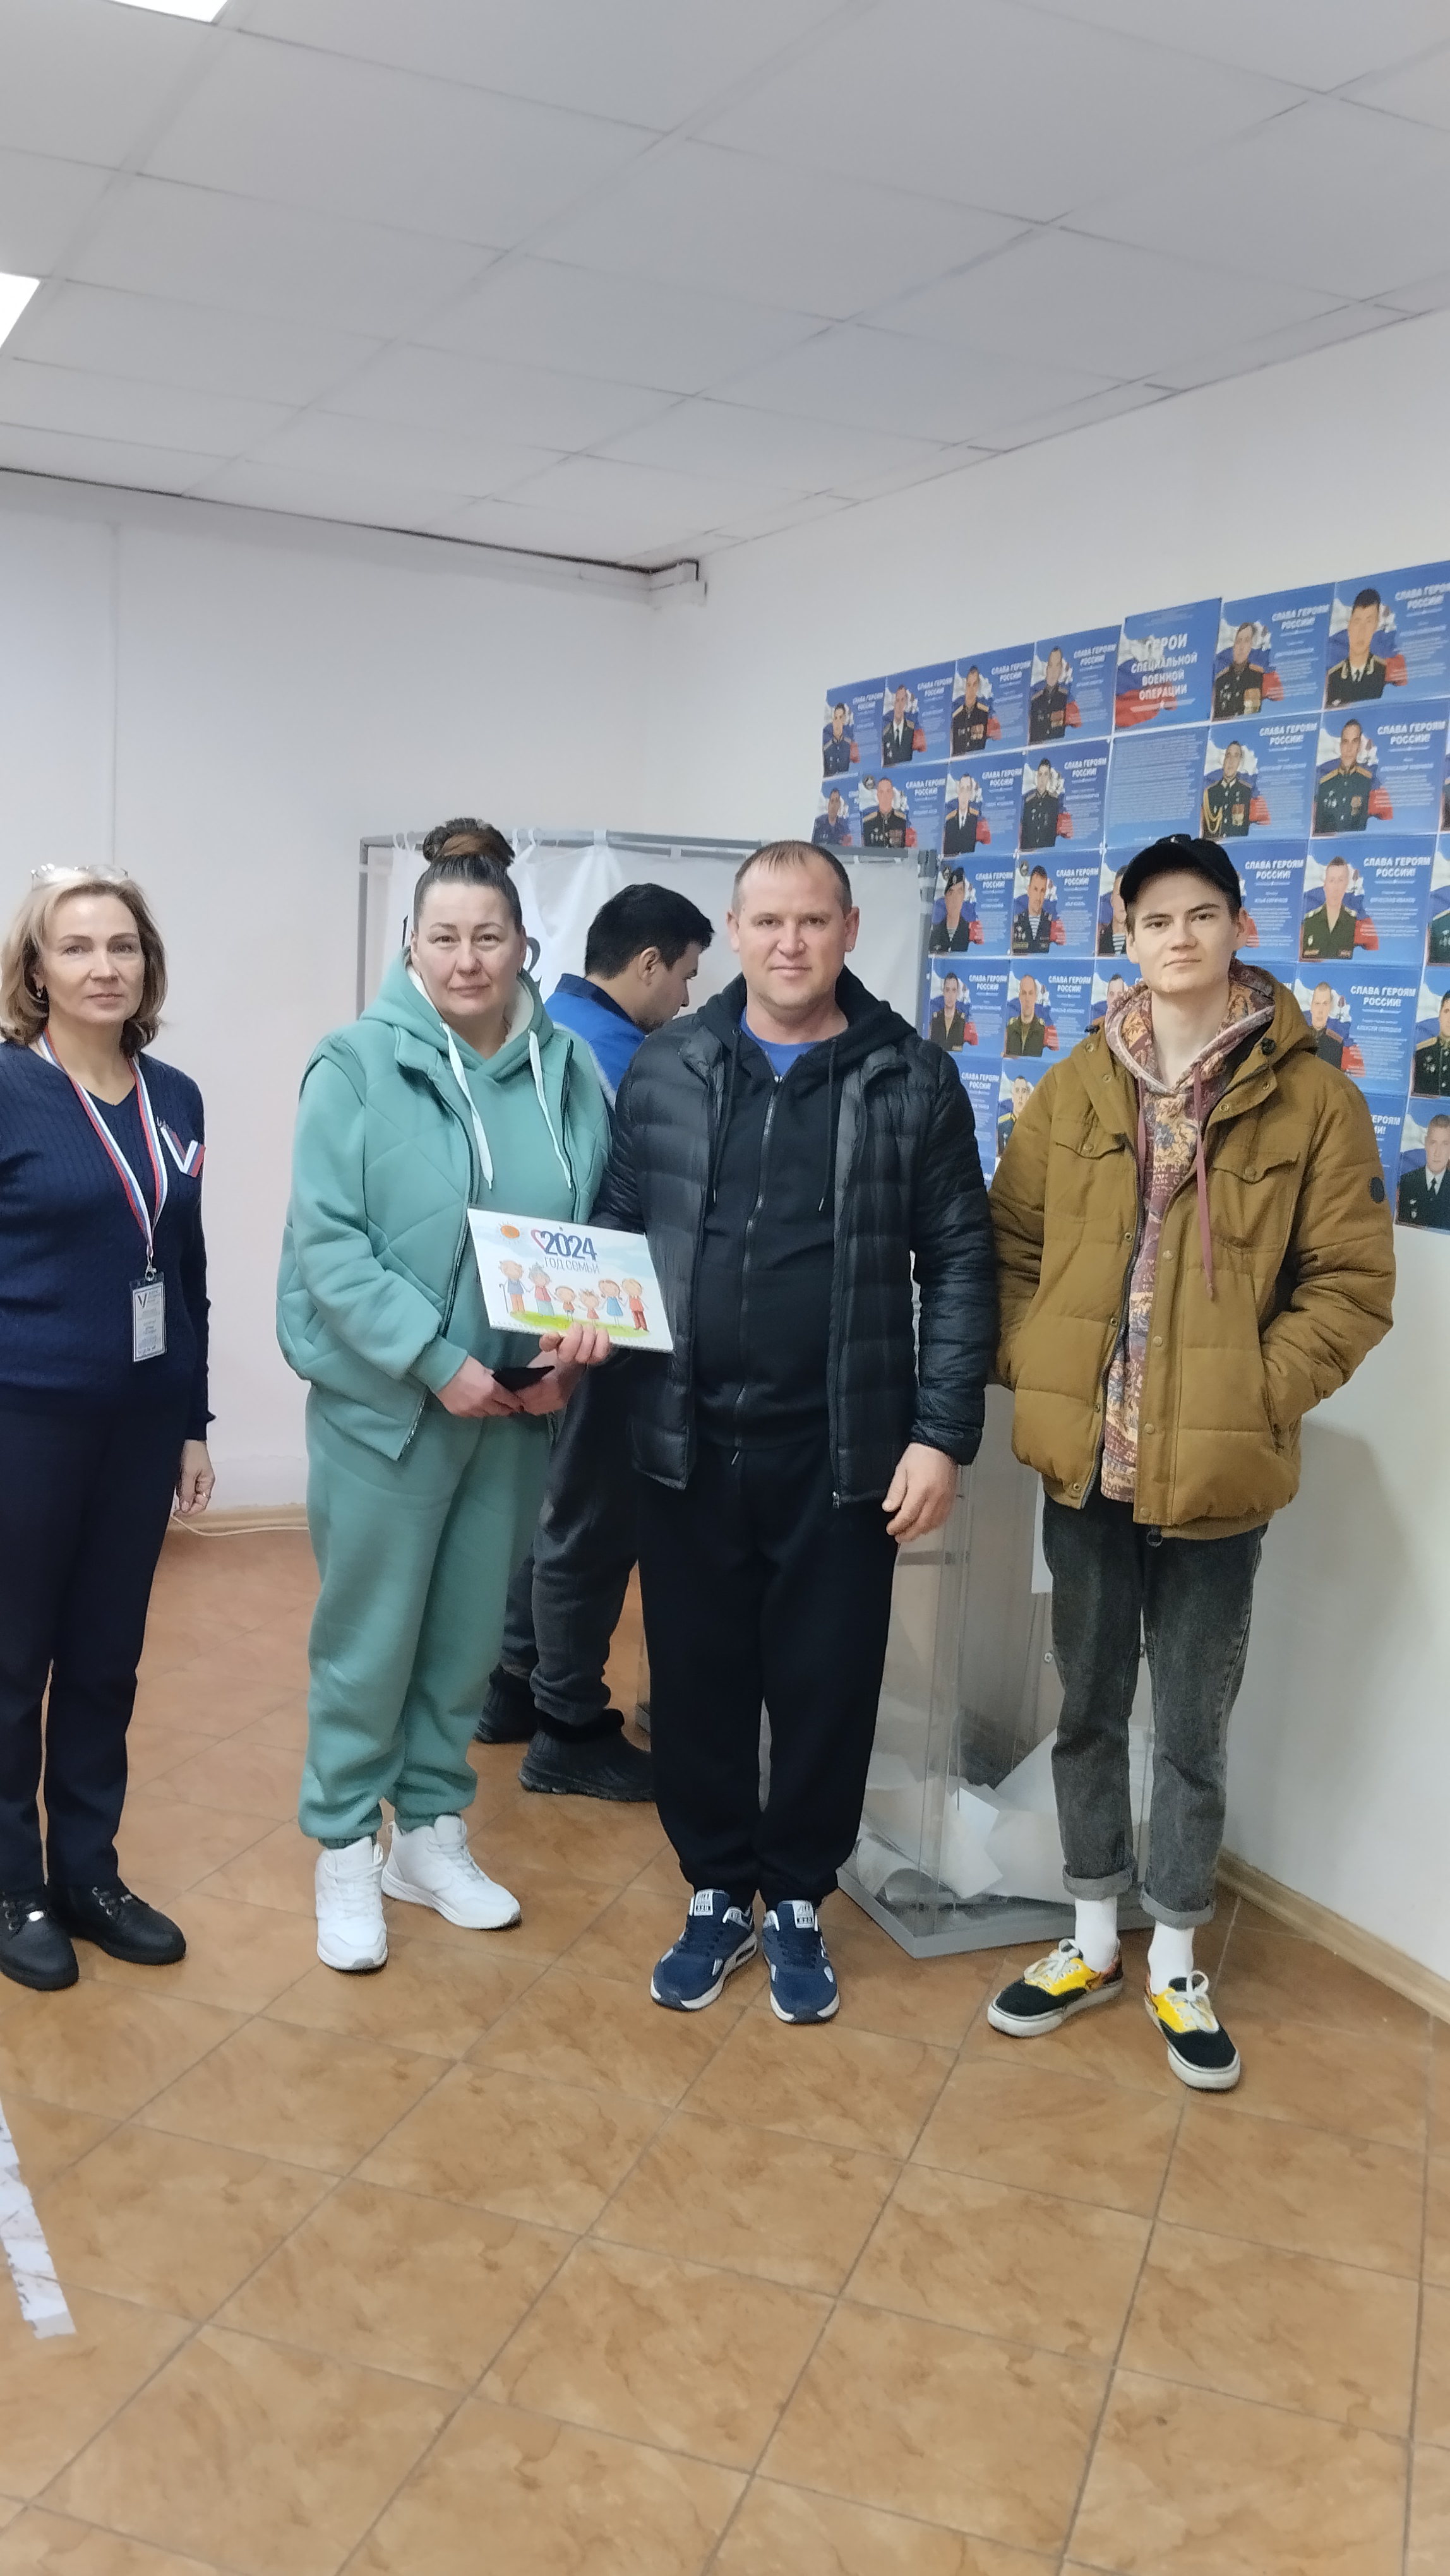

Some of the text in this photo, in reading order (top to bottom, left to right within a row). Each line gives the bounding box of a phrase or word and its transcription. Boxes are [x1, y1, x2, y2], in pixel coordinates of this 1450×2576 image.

[1145, 633, 1188, 653] ГЕРОИ
[1131, 652, 1198, 673] СПЕЦИАЛЬНОЙ
[1142, 668, 1185, 686] ВОЕННОЙ
[1139, 684, 1187, 701] ОПЕРАЦИИ
[1259, 722, 1317, 736] СЛАВА ГЕРОЯМ
[1377, 721, 1445, 735] СЛАВА ГЕРОЯМ
[1064, 760, 1082, 770] СЛАВА
[1245, 859, 1303, 869] СЛАВА ГЕРОЯМ
[1364, 857, 1431, 866] СЛАВА ГЕРОЯМ
[1056, 868, 1099, 878] СЛАВА ГЕРОЯМ
[1069, 976, 1091, 984] ГЕРОЯМ
[1350, 986, 1416, 996] СЛАВА ГЕРОЯМ
[1363, 998, 1401, 1006] РОССИИ!
[961, 1072, 999, 1082] СЛАВА ГЕРОЯМ
[1370, 1114, 1401, 1125] ЕРОЯМ
[540, 1231, 597, 1261] 2024
[544, 1256, 600, 1274] ГОД СЕМЬИ
